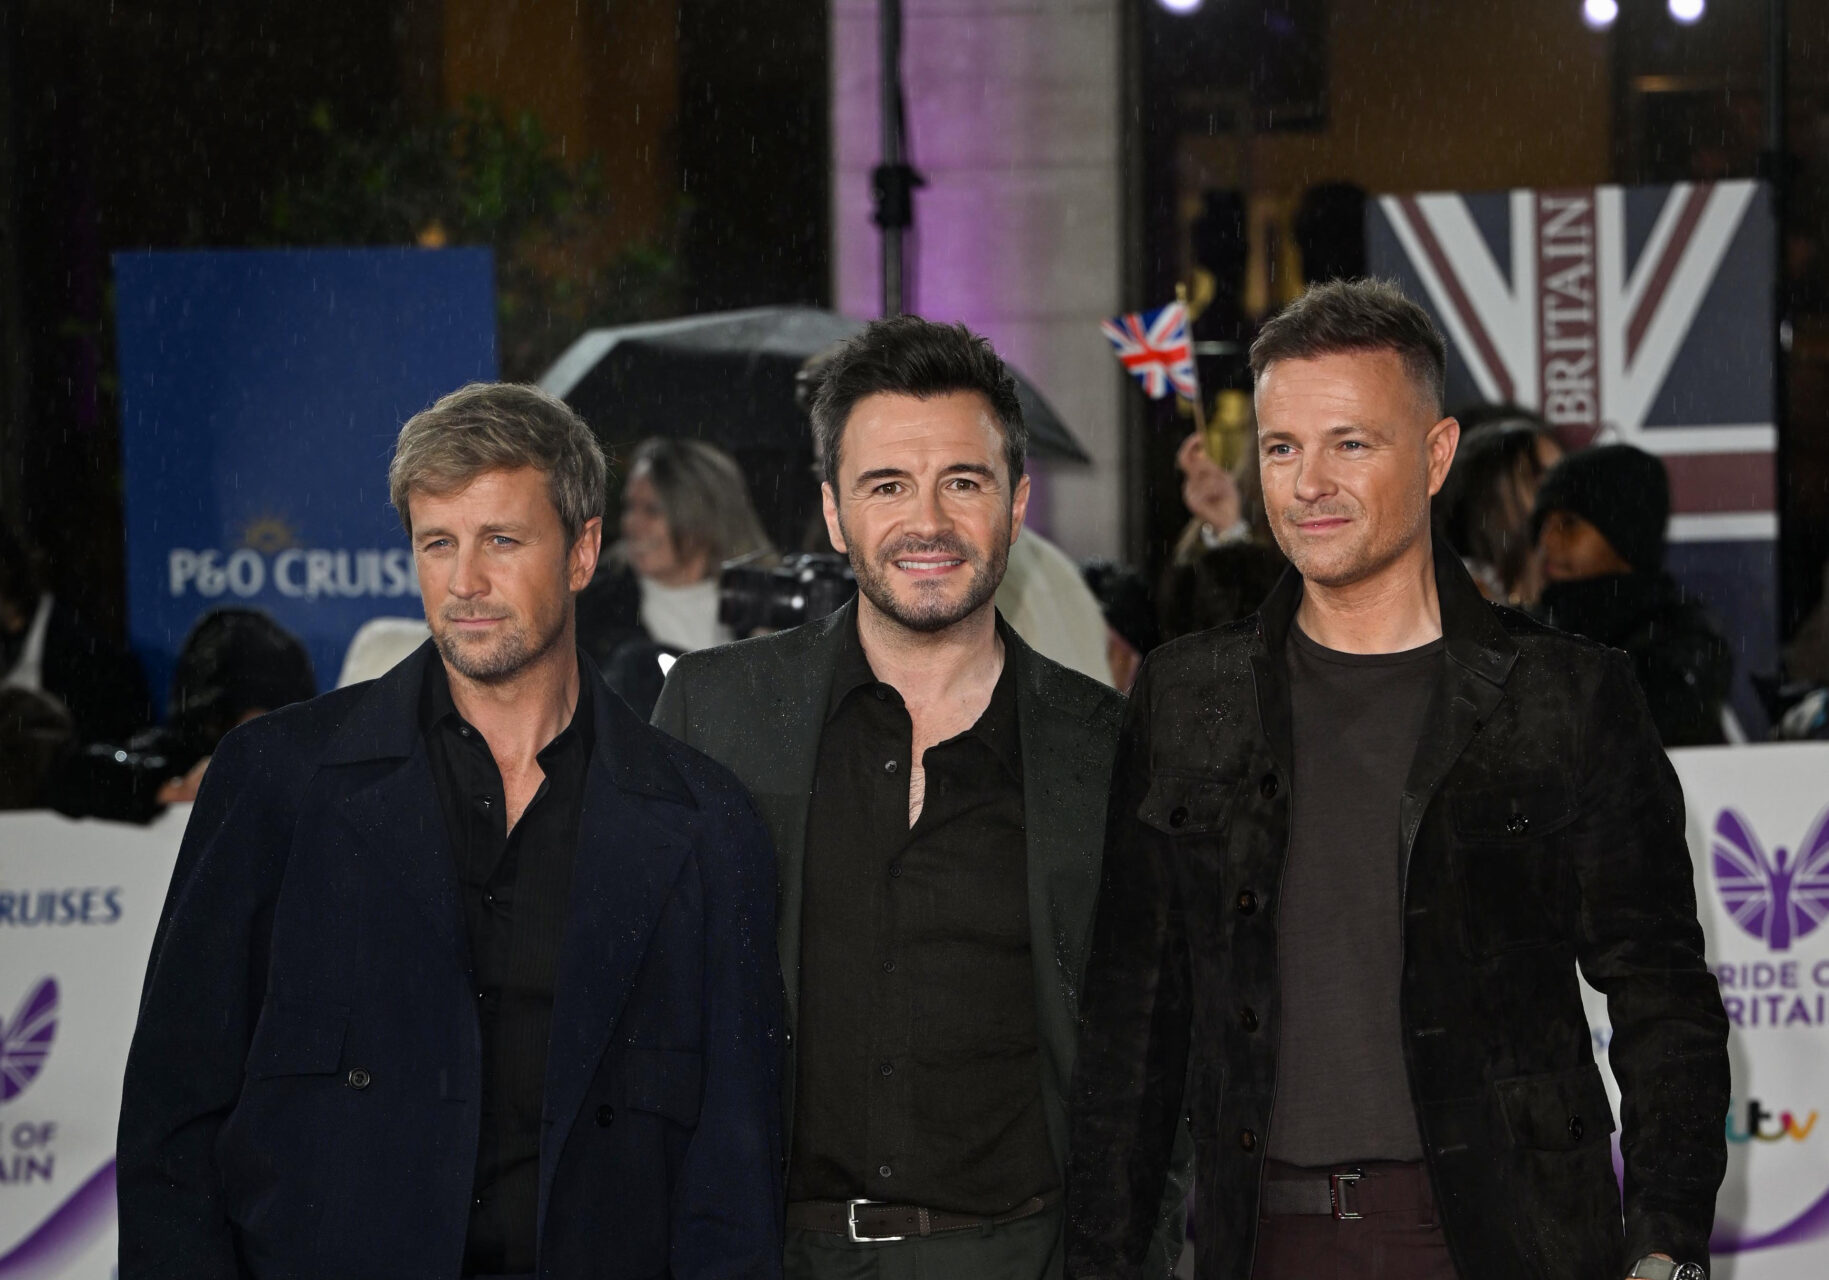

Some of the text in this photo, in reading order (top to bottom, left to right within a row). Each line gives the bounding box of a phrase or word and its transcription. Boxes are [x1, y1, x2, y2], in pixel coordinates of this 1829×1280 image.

[1542, 196, 1597, 424] BRITAIN
[168, 548, 266, 598] P&O
[1706, 961, 1798, 990] RIDE
[11, 1121, 57, 1150] OF
[1725, 1098, 1819, 1143] itv
